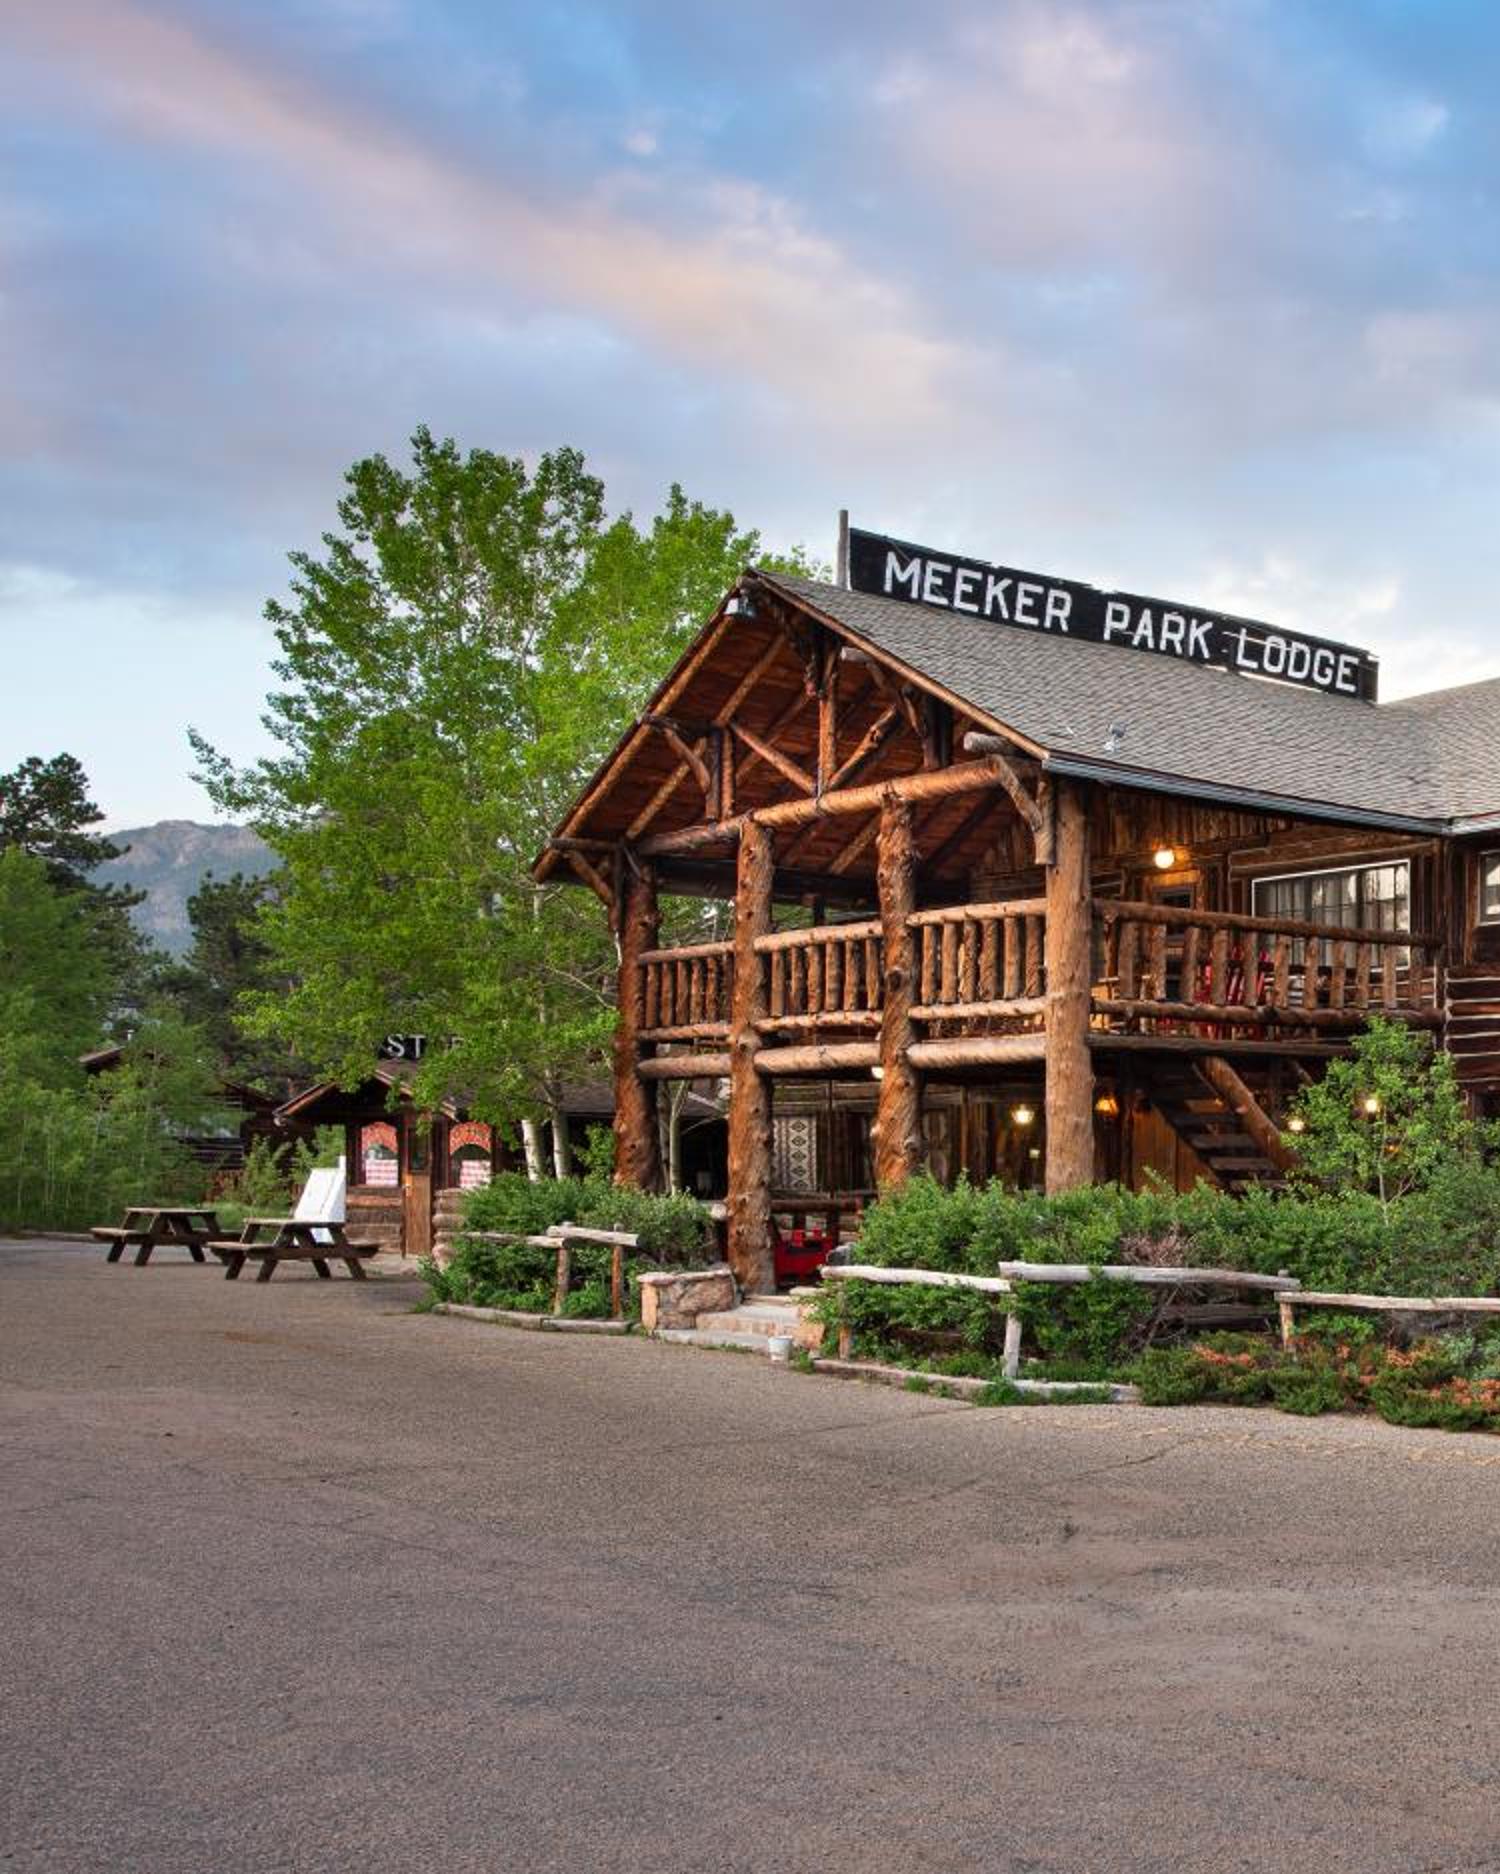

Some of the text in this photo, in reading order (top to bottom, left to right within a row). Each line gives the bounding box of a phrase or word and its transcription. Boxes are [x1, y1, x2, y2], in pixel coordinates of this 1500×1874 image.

[884, 551, 1359, 692] MEEKER PARK LODGE
